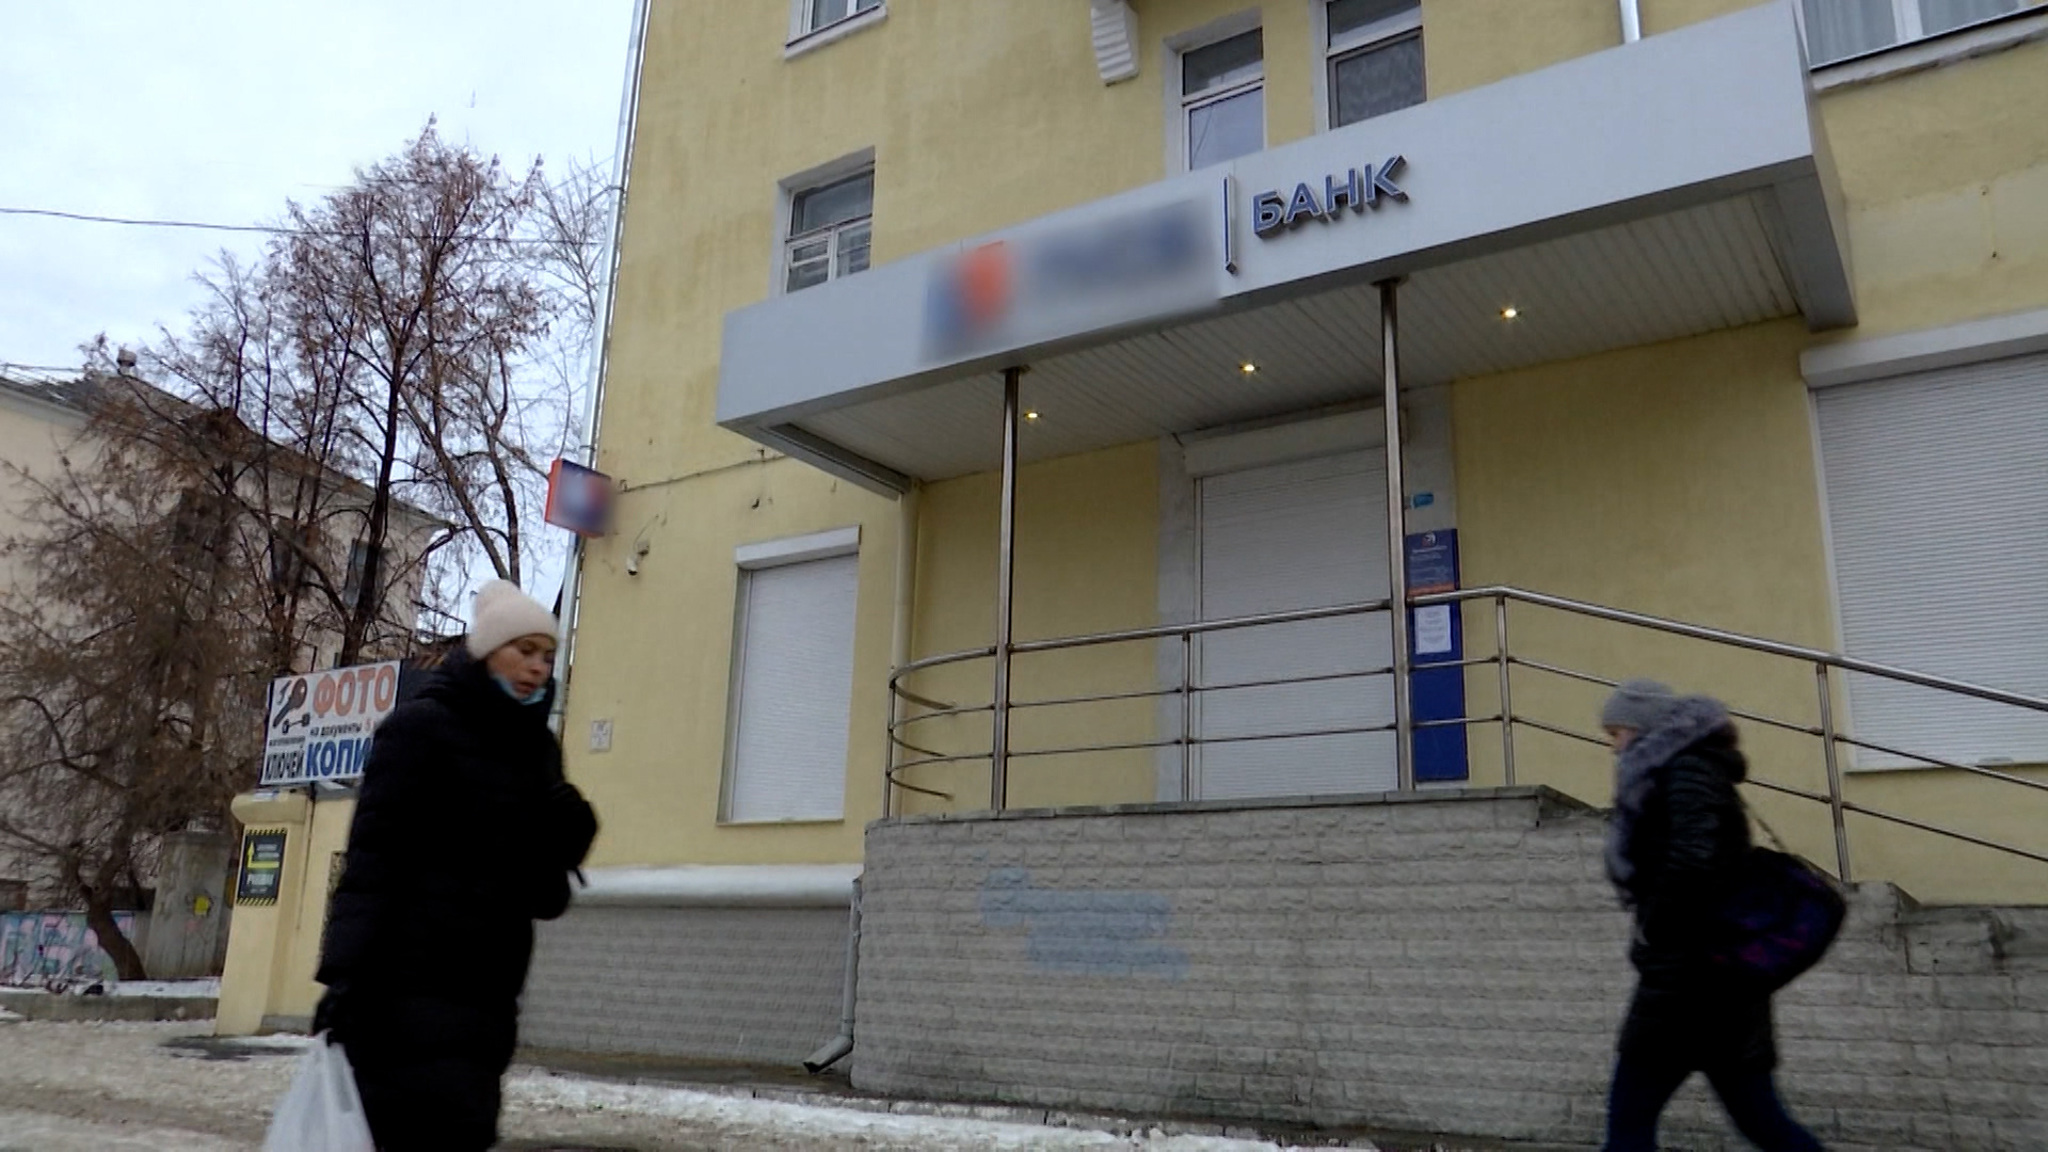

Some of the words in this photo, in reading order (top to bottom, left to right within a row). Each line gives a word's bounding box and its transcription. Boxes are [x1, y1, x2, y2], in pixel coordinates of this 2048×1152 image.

[1252, 155, 1408, 238] БАНК
[313, 664, 396, 719] ФОТО
[310, 726, 320, 736] на
[320, 723, 362, 738] документы
[265, 746, 305, 781] КЛЮЧЕЙ
[305, 737, 373, 778] КОПИ
